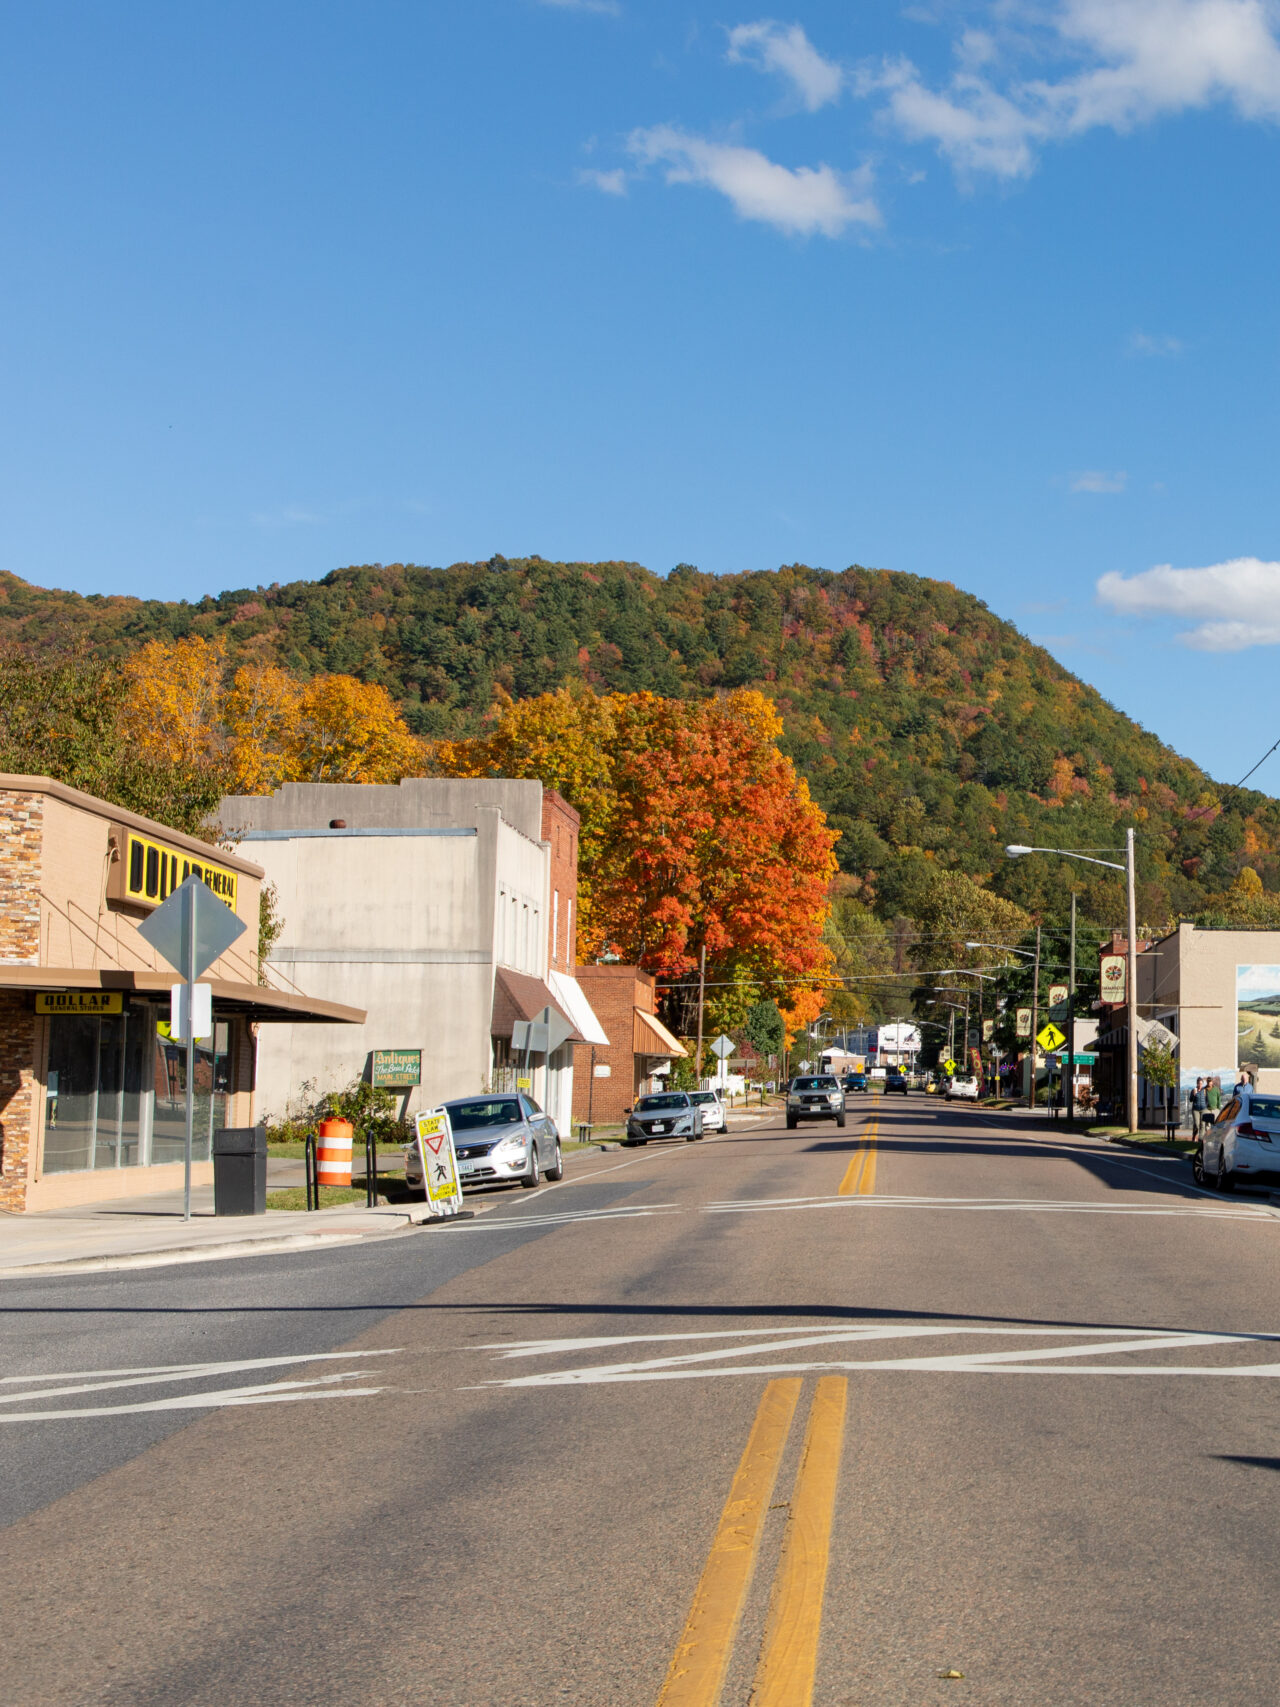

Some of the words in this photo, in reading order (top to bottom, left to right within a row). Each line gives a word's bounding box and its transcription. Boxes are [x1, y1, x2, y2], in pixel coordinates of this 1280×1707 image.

[130, 839, 203, 902] DOLL
[44, 994, 111, 1006] DOLLAR
[422, 1118, 441, 1128] STATE
[426, 1125, 439, 1133] LAW
